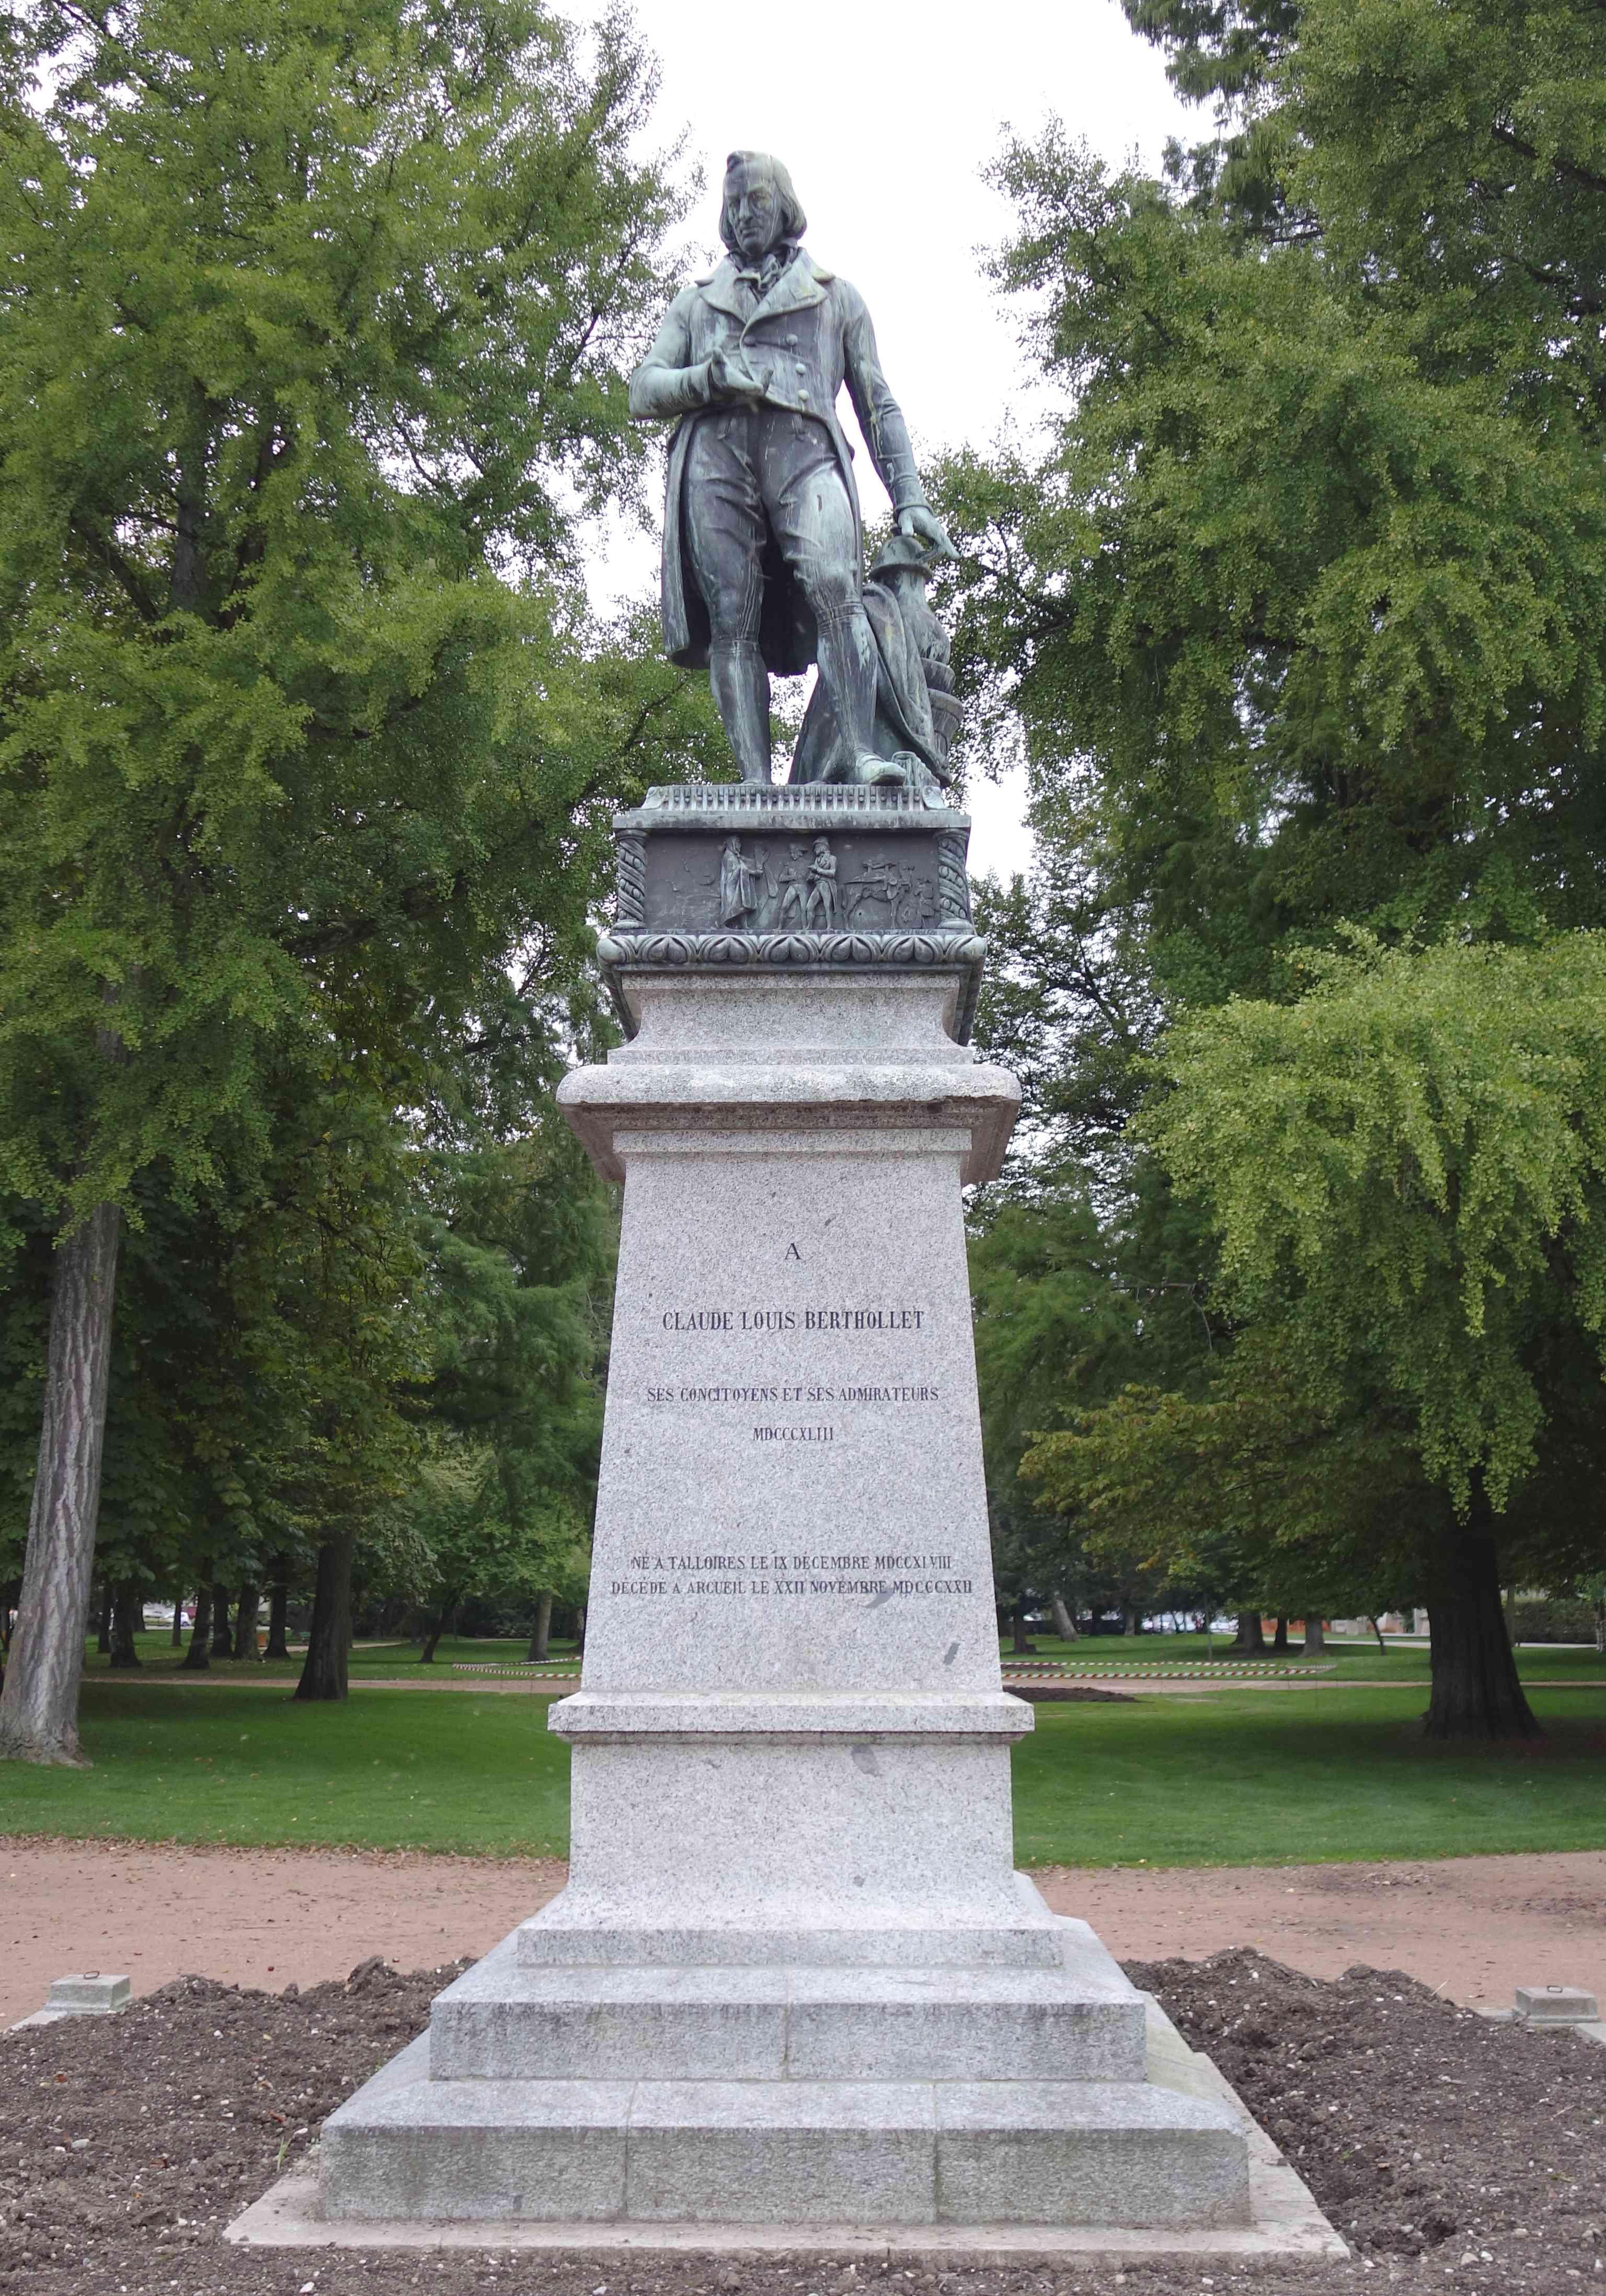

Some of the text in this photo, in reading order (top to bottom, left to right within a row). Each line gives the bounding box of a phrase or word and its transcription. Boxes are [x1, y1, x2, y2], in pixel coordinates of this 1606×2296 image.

[785, 1243, 801, 1260] A
[662, 1311, 924, 1330] CLAUDE LOUIS BERTHOLLET
[647, 1387, 939, 1402] SES CONCITOYENS ET SES ADMIRATEURS
[753, 1428, 834, 1441] MDCCCXLIII
[668, 1556, 745, 1569] TALLOIRES
[751, 1556, 769, 1569] LE
[774, 1556, 787, 1569] IX
[687, 1581, 746, 1594] ARCUEIL
[751, 1581, 770, 1594] LE
[774, 1581, 805, 1594] XXII
[892, 1580, 972, 1594] MDCCCXXII
